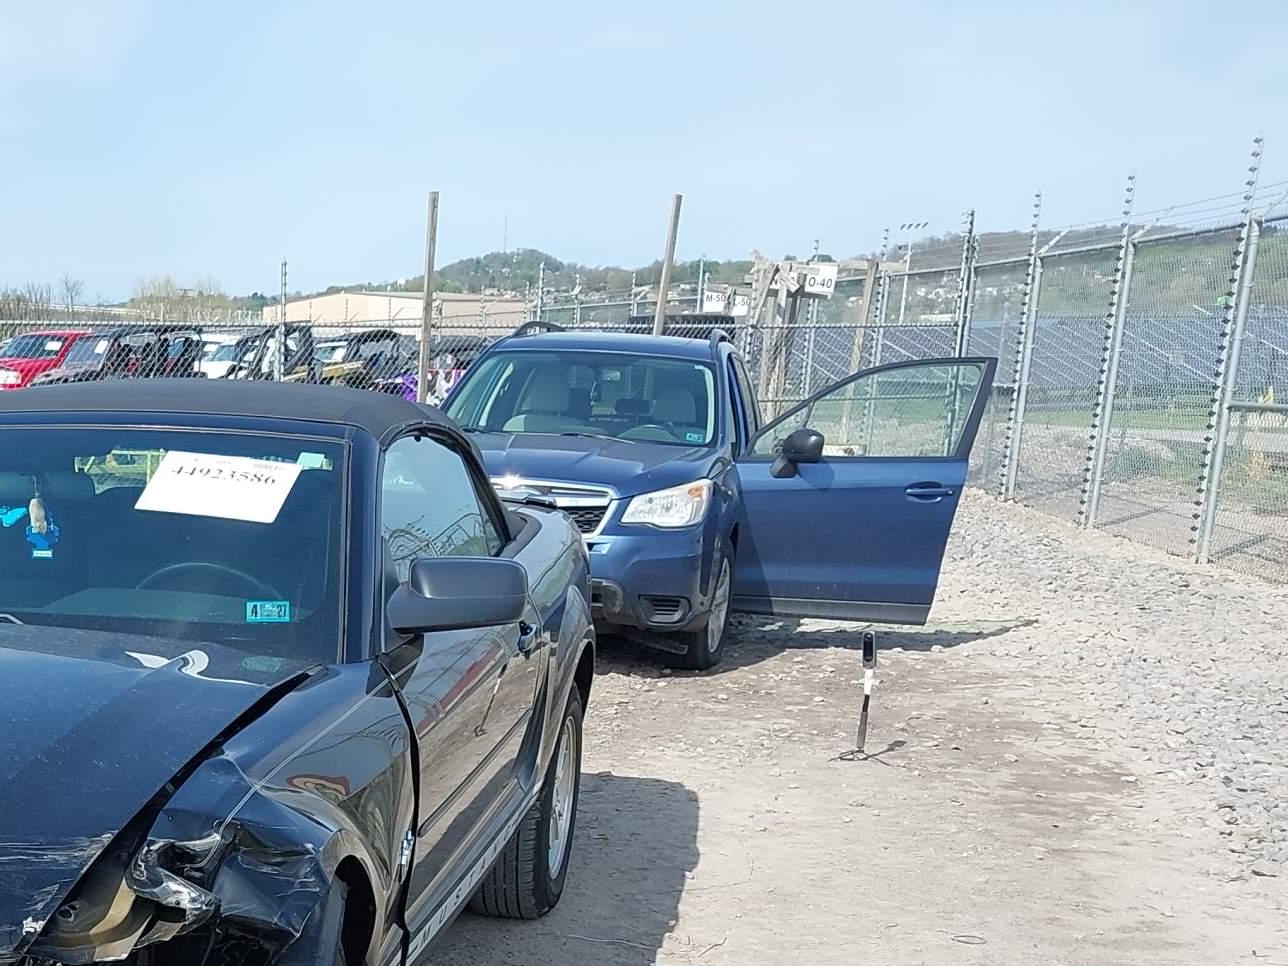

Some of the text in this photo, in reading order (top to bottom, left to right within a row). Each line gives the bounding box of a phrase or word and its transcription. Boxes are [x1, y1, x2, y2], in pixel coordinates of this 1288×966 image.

[808, 276, 833, 289] O-40
[706, 294, 726, 303] M-50
[171, 465, 276, 485] 44923586
[250, 603, 259, 618] 4
[276, 603, 288, 618] 27
